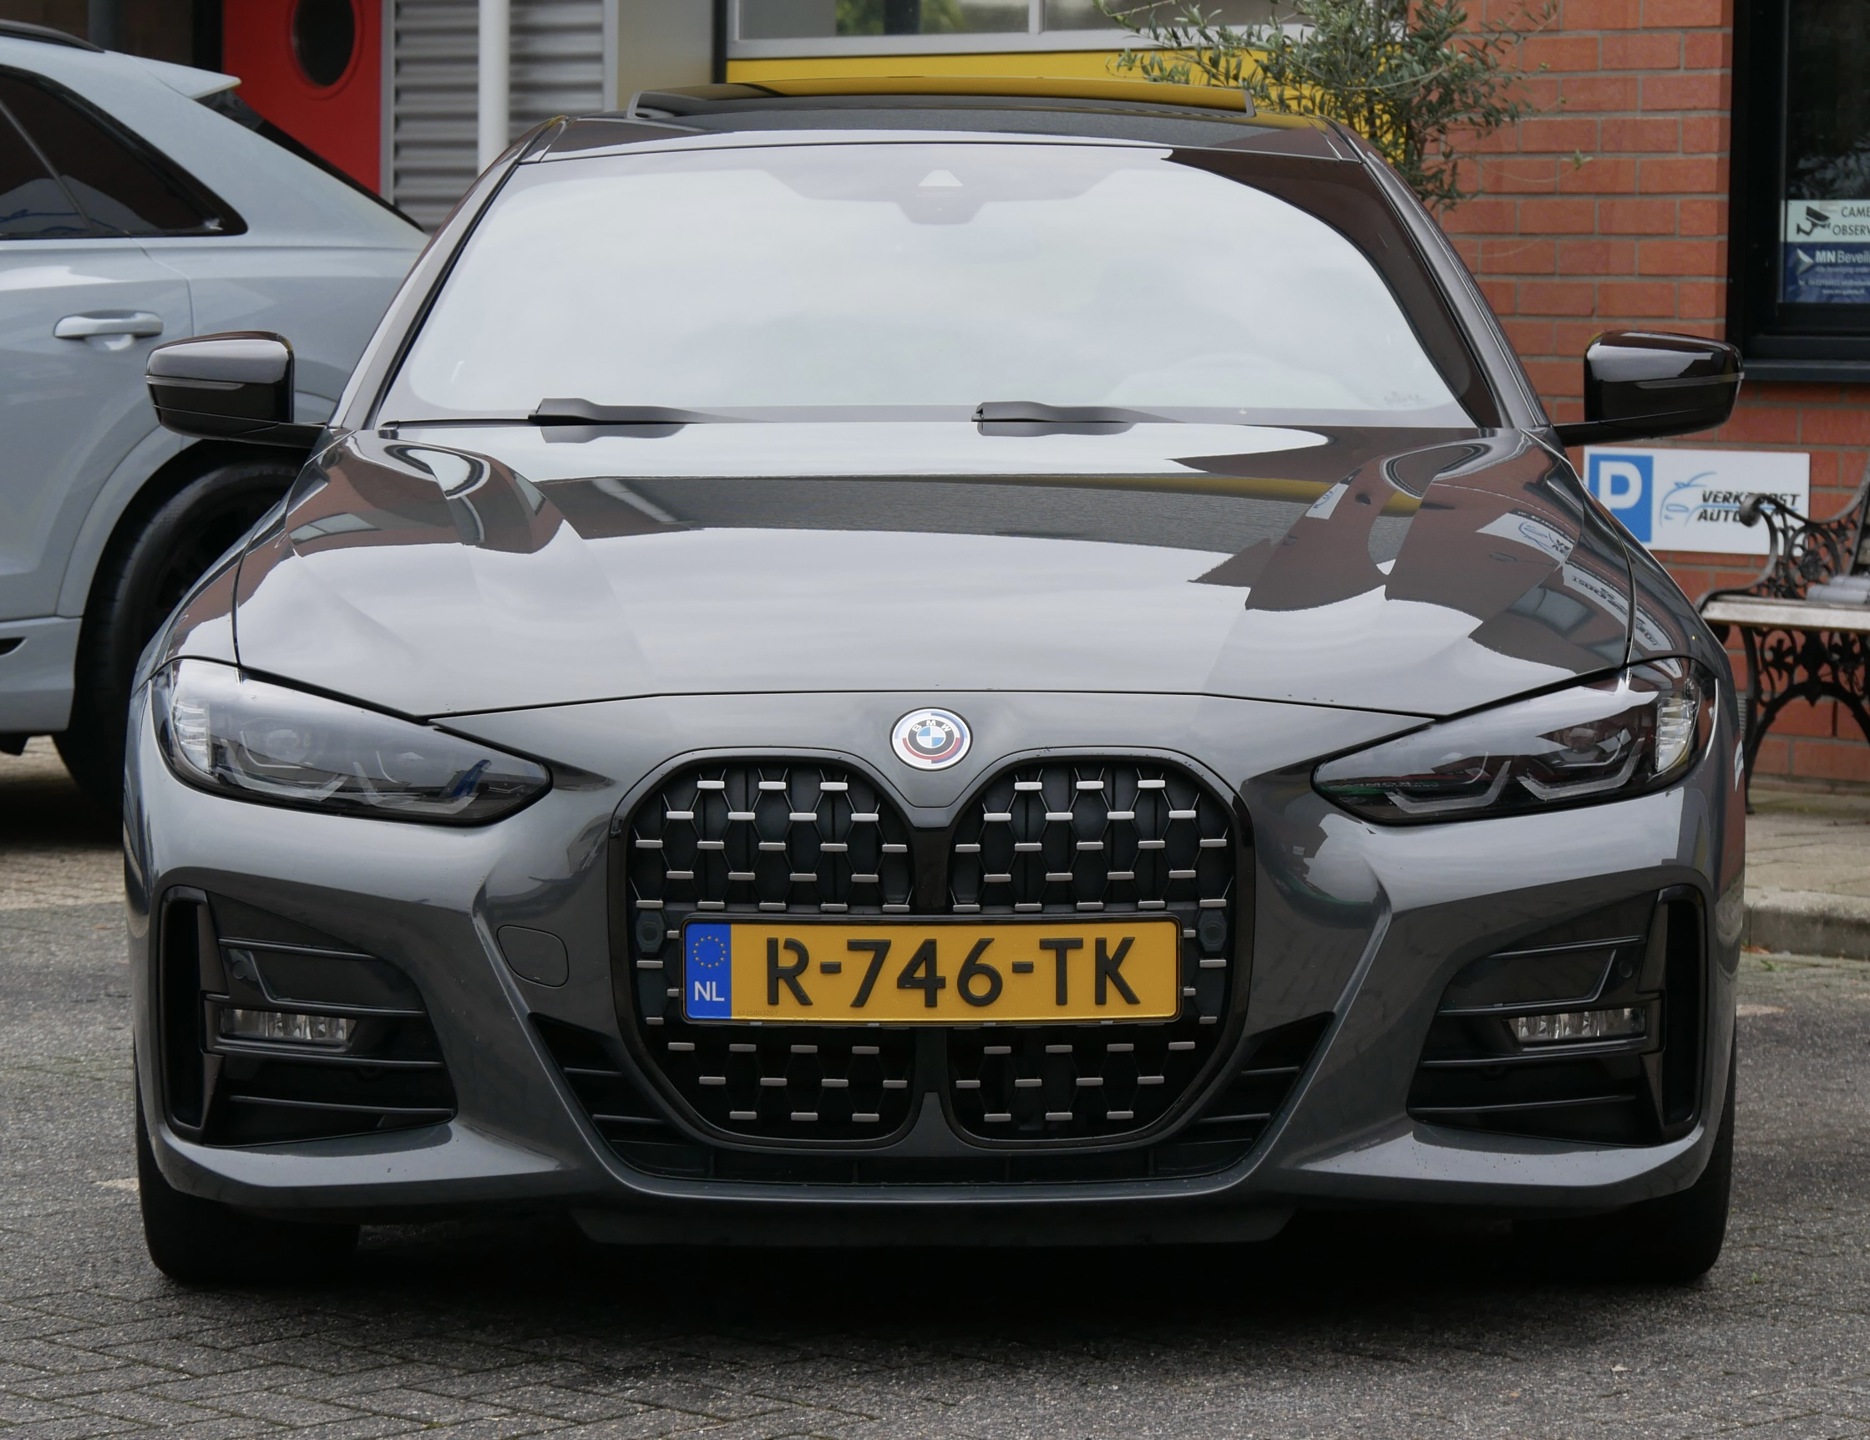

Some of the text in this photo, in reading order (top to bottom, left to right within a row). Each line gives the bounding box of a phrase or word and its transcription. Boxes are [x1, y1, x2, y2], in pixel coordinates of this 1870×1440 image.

[1815, 250, 1836, 263] MN
[1599, 460, 1643, 509] P
[912, 719, 951, 732] BMW
[766, 936, 1141, 1008] R-746-TK
[694, 981, 725, 1001] NL
